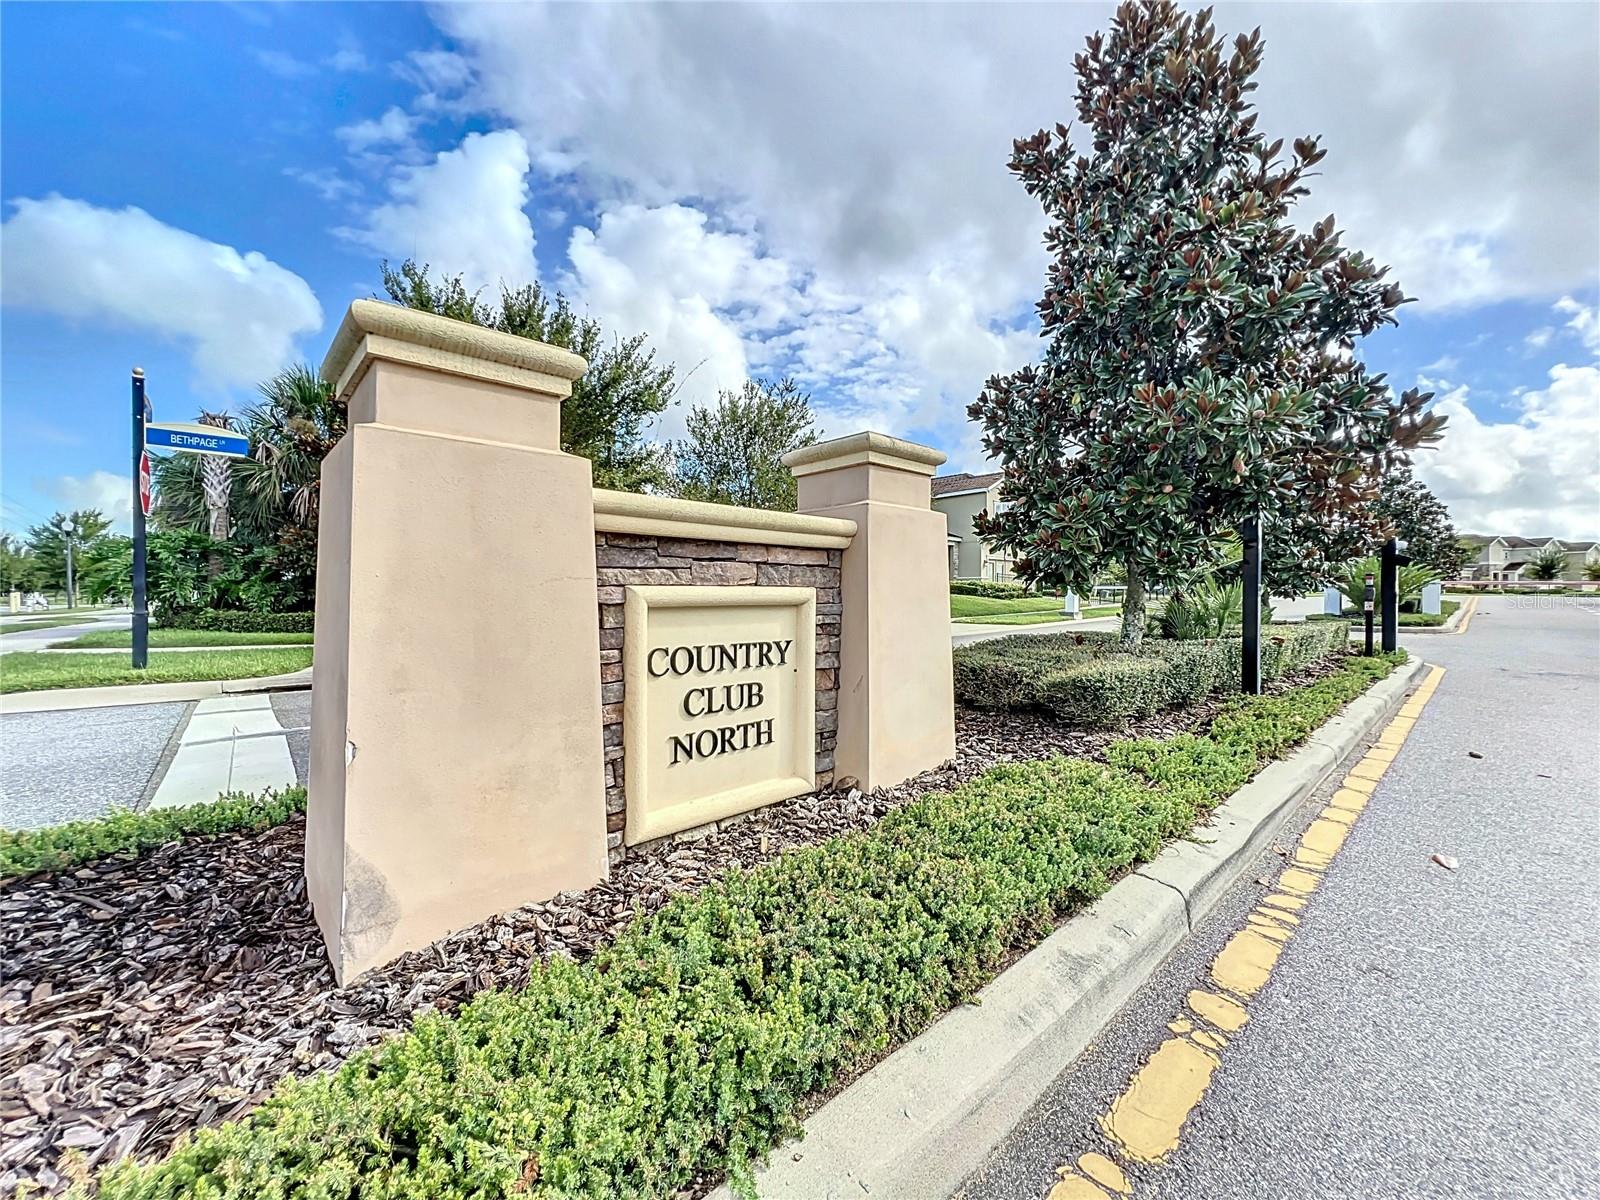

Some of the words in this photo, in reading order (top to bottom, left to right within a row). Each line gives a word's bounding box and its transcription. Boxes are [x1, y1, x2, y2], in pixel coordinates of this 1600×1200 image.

[170, 434, 218, 448] BETHPAGE
[647, 640, 793, 677] COUNTRY
[683, 682, 764, 717] CLUB
[668, 718, 775, 765] NORTH
